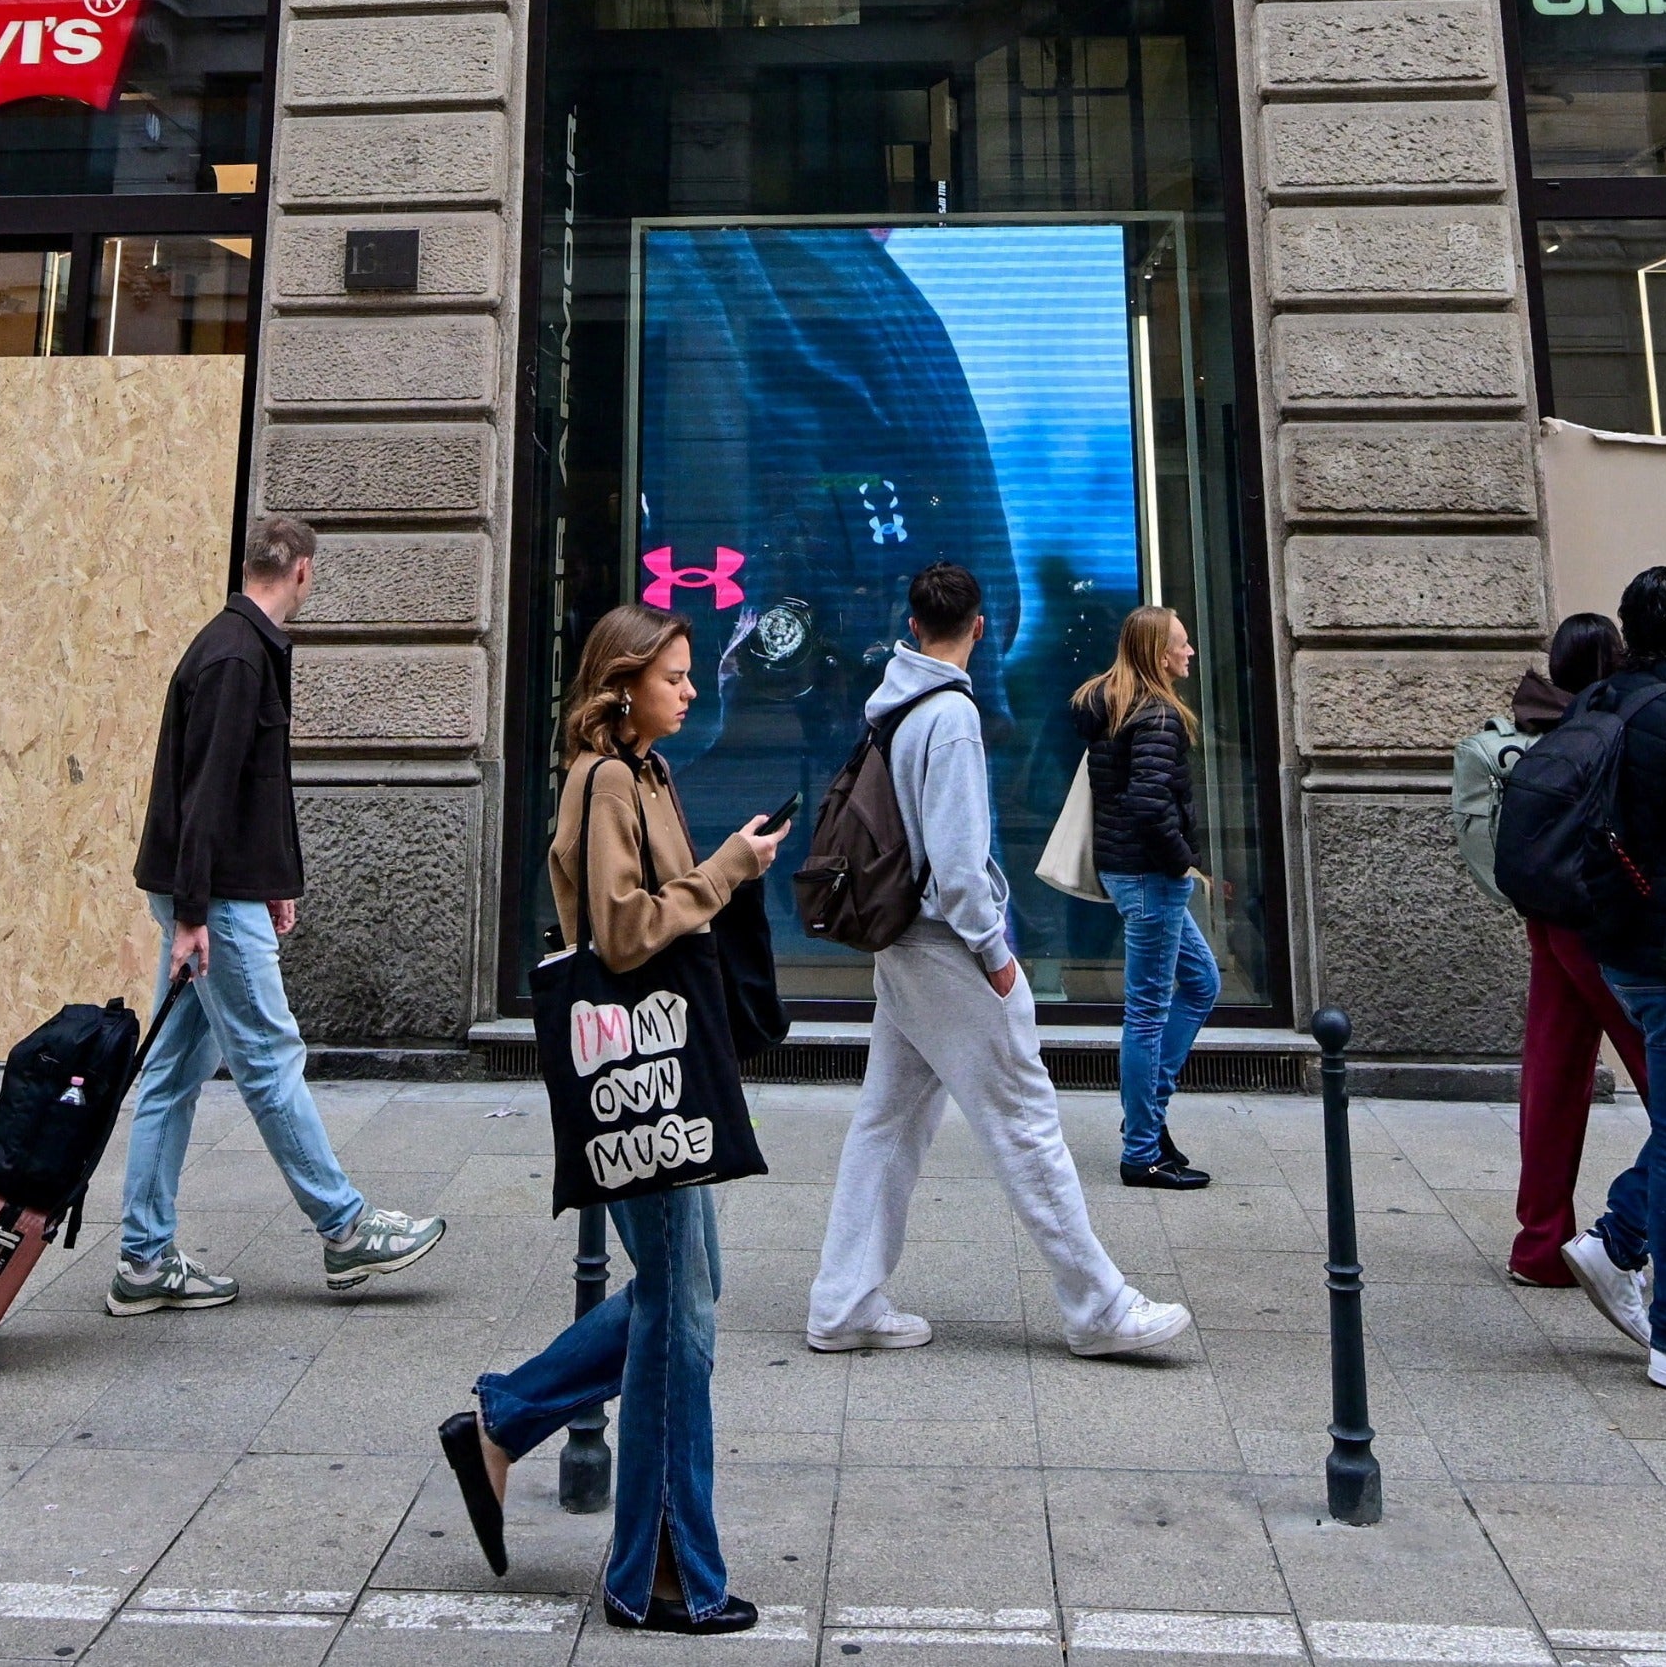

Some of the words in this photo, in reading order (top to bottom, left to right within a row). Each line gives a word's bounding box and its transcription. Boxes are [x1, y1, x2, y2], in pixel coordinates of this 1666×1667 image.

[555, 112, 578, 487] ARMOUR
[576, 1007, 629, 1063] I'M
[636, 998, 679, 1046] MY
[595, 1059, 676, 1115] OWN
[592, 1120, 708, 1182] MUSE
[365, 1234, 385, 1251] N
[161, 1272, 184, 1289] N
